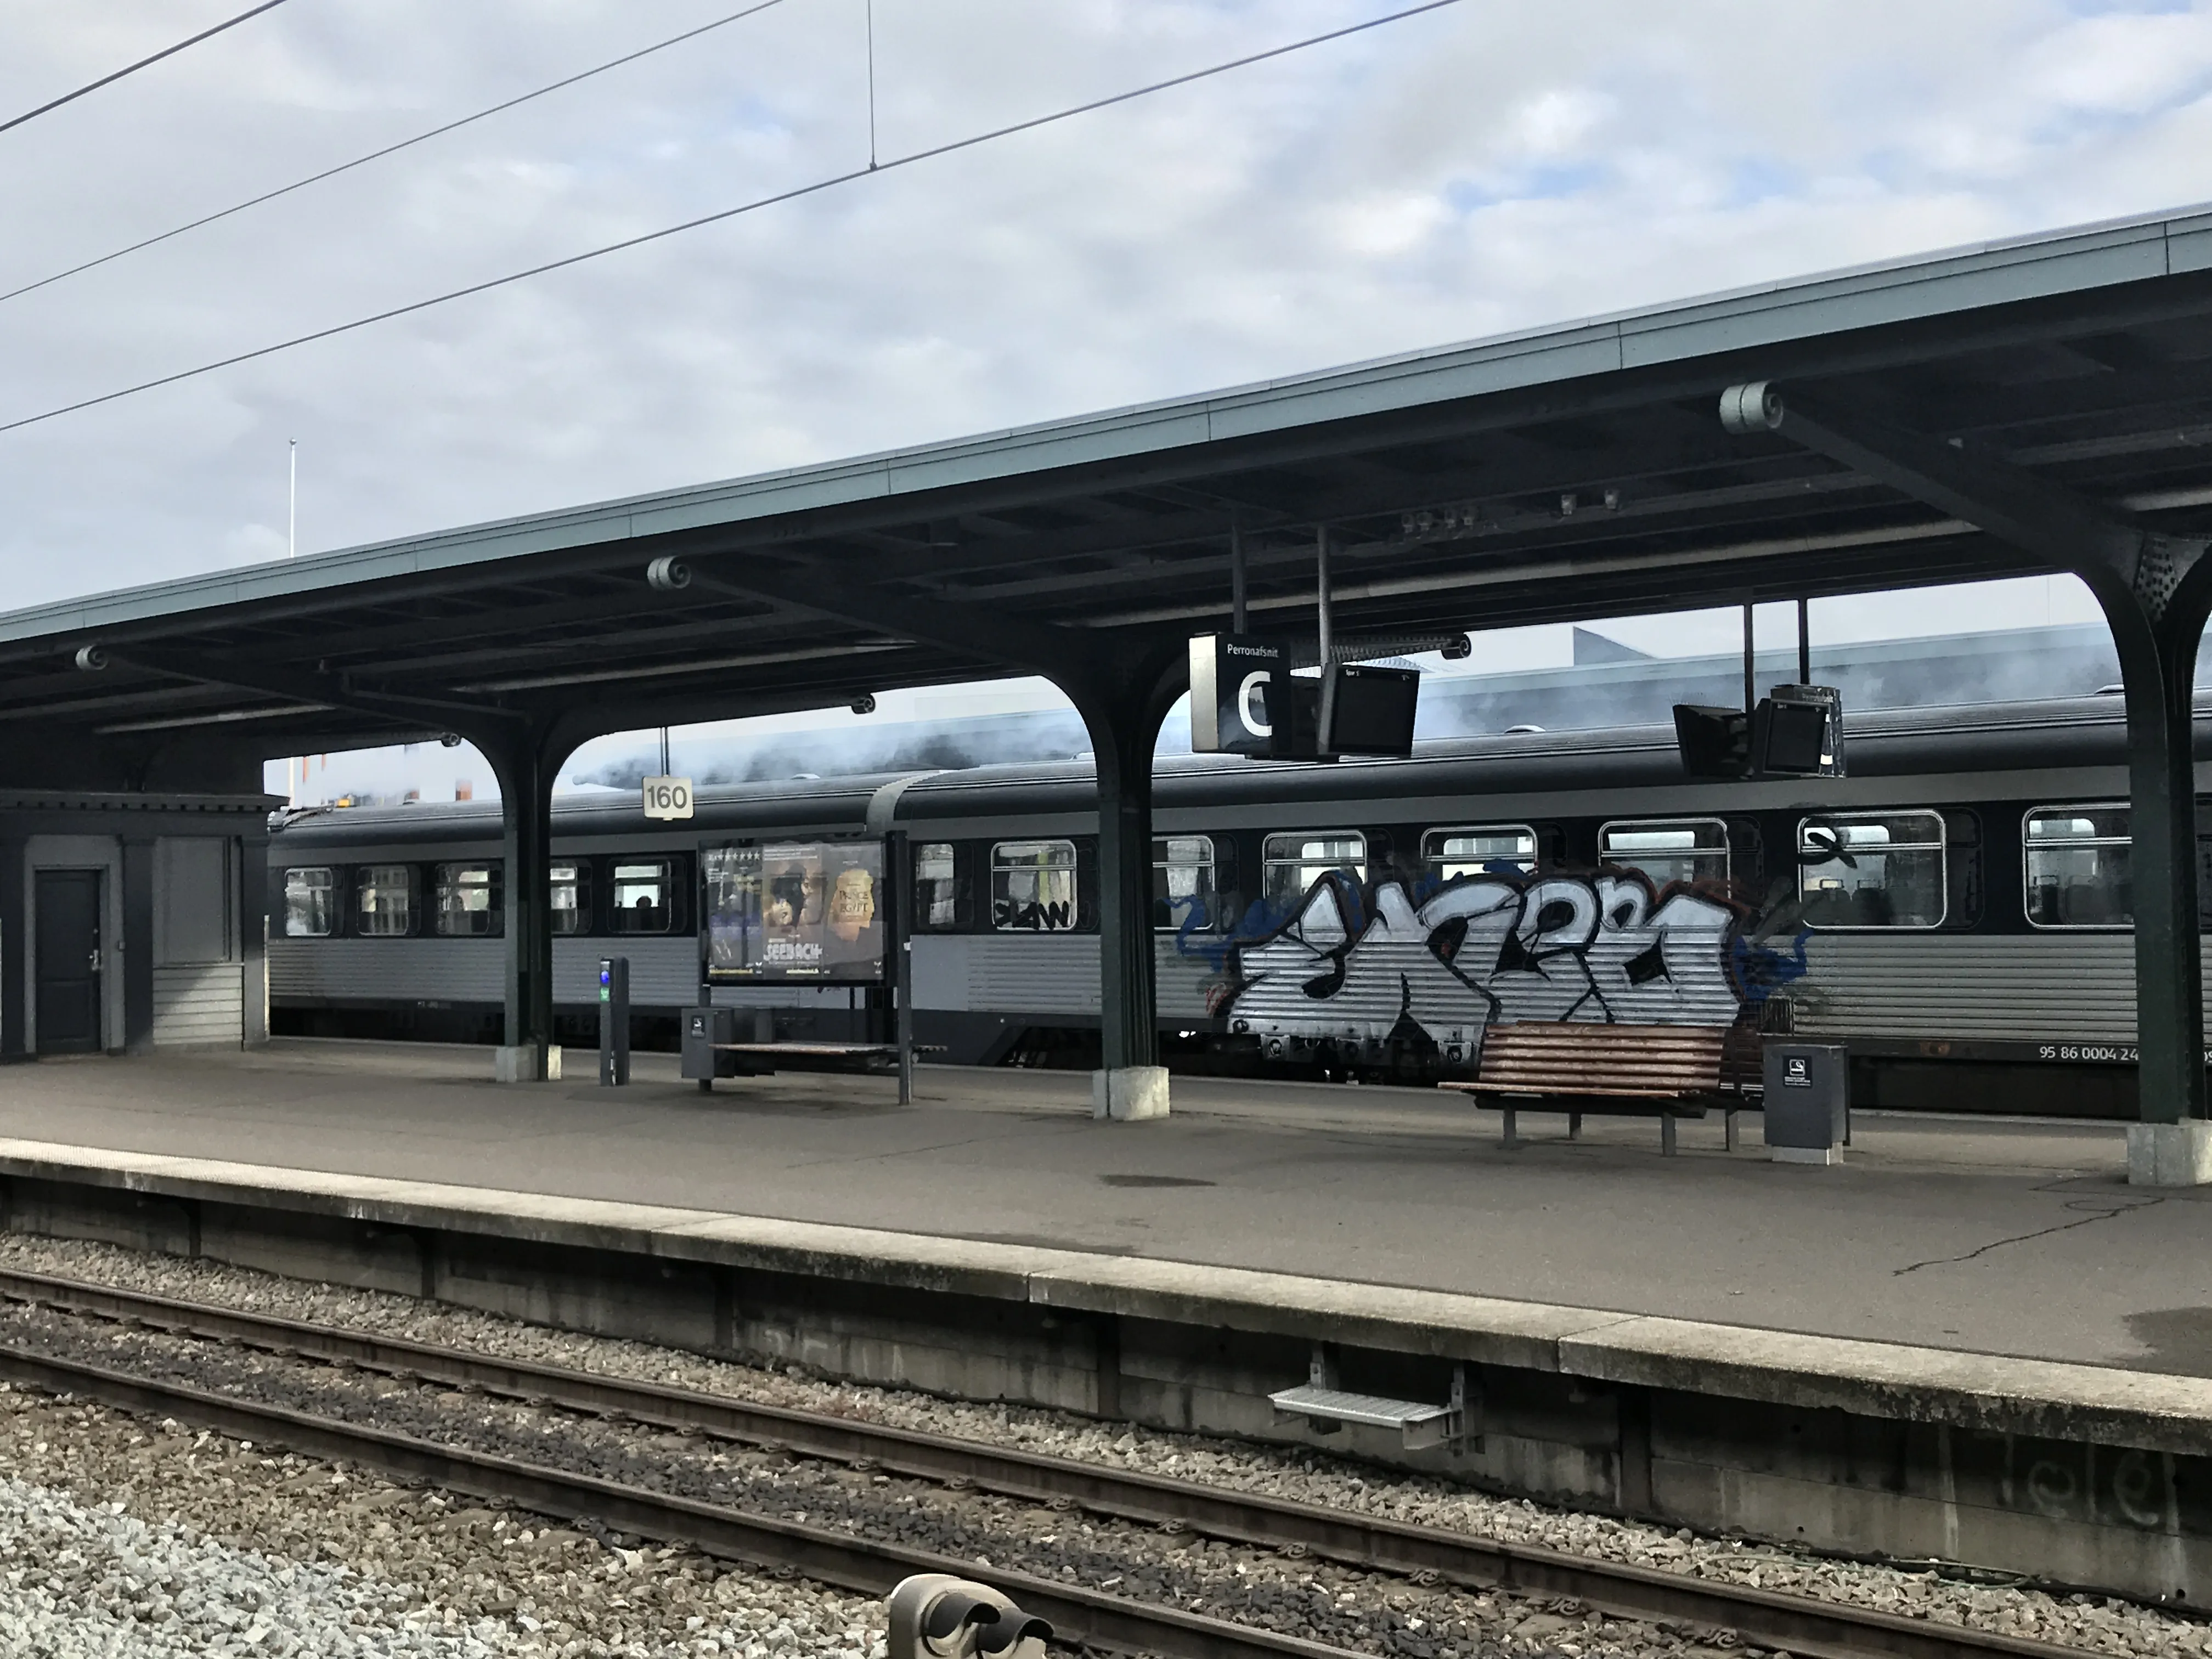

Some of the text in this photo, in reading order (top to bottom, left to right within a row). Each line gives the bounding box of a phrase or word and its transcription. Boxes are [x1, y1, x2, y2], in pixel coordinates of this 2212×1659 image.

[1227, 644, 1279, 658] Perronafsnit
[1238, 670, 1273, 737] C
[647, 786, 687, 809] 160
[2039, 1046, 2056, 1058] 95
[2061, 1047, 2078, 1059] 86
[2081, 1047, 2117, 1060] 0004
